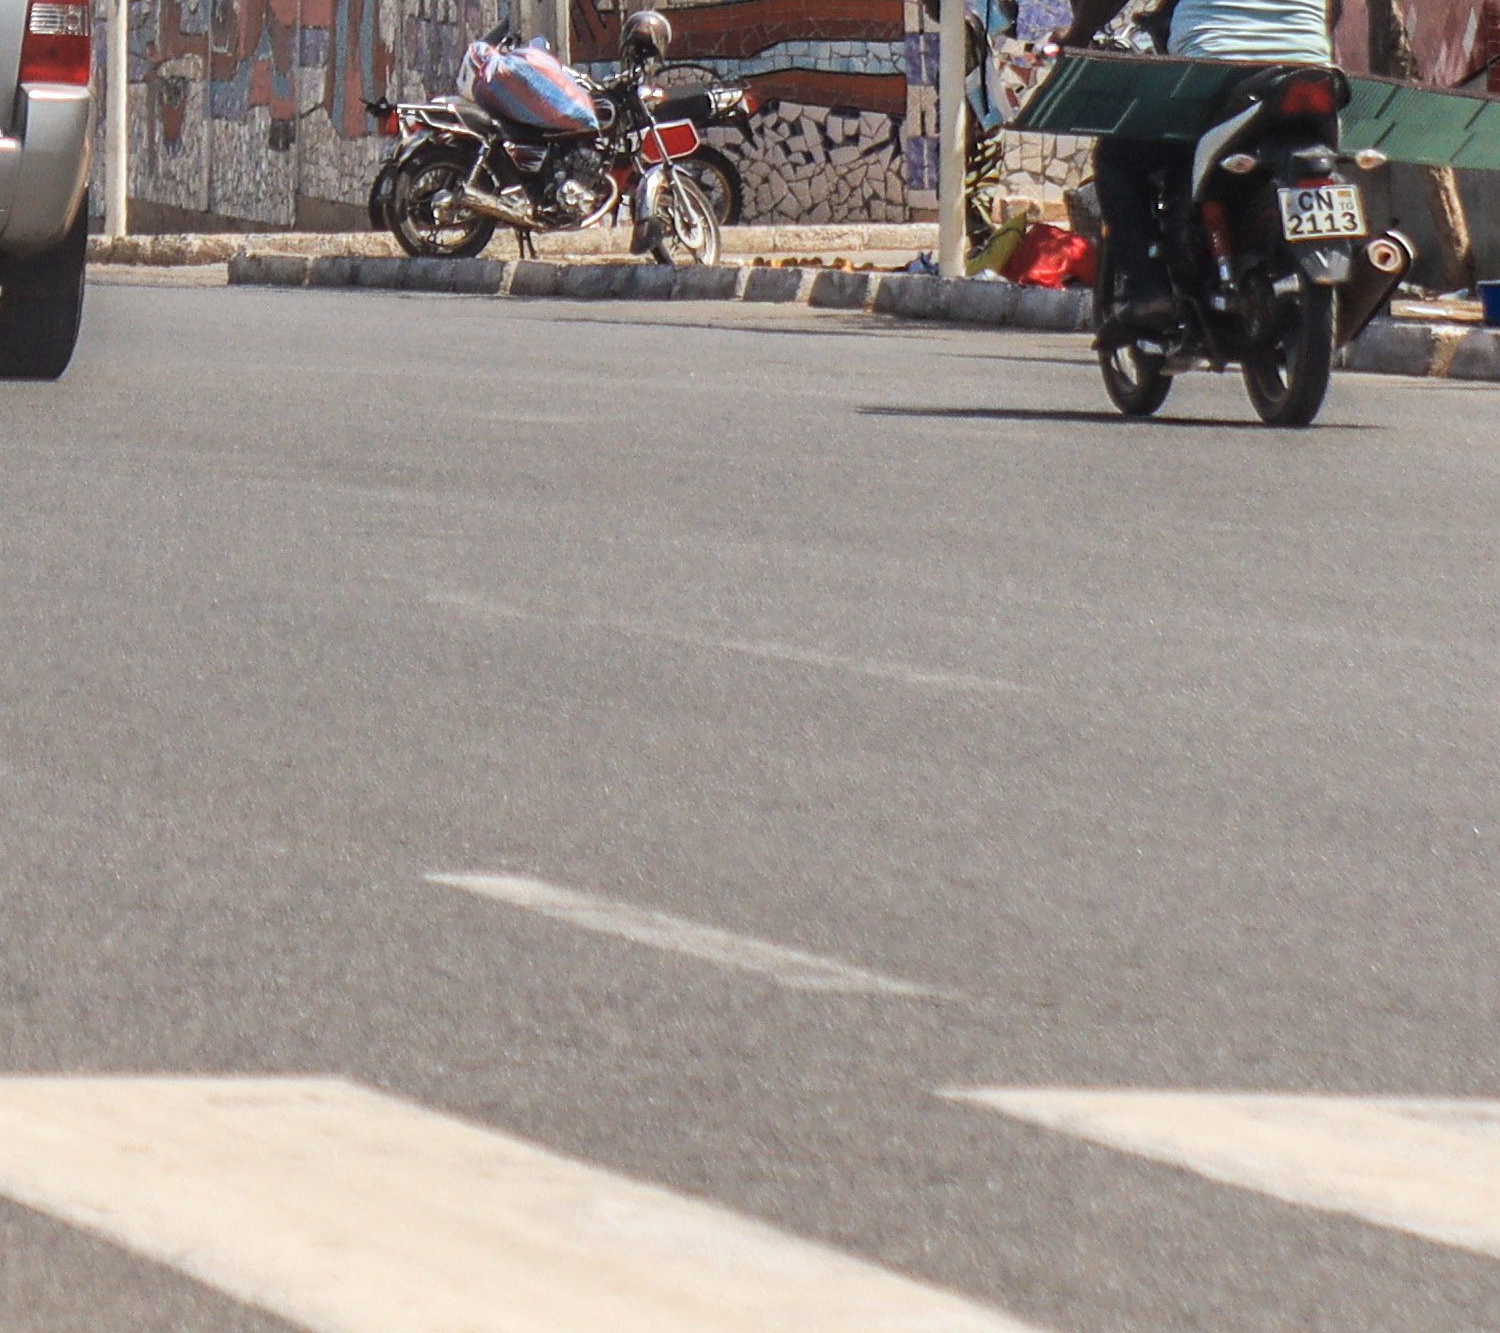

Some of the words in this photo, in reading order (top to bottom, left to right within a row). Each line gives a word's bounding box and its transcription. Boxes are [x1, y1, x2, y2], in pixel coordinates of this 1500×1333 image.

[1298, 190, 1334, 212] CN
[1339, 201, 1354, 211] TG
[1287, 211, 1358, 235] 2113
